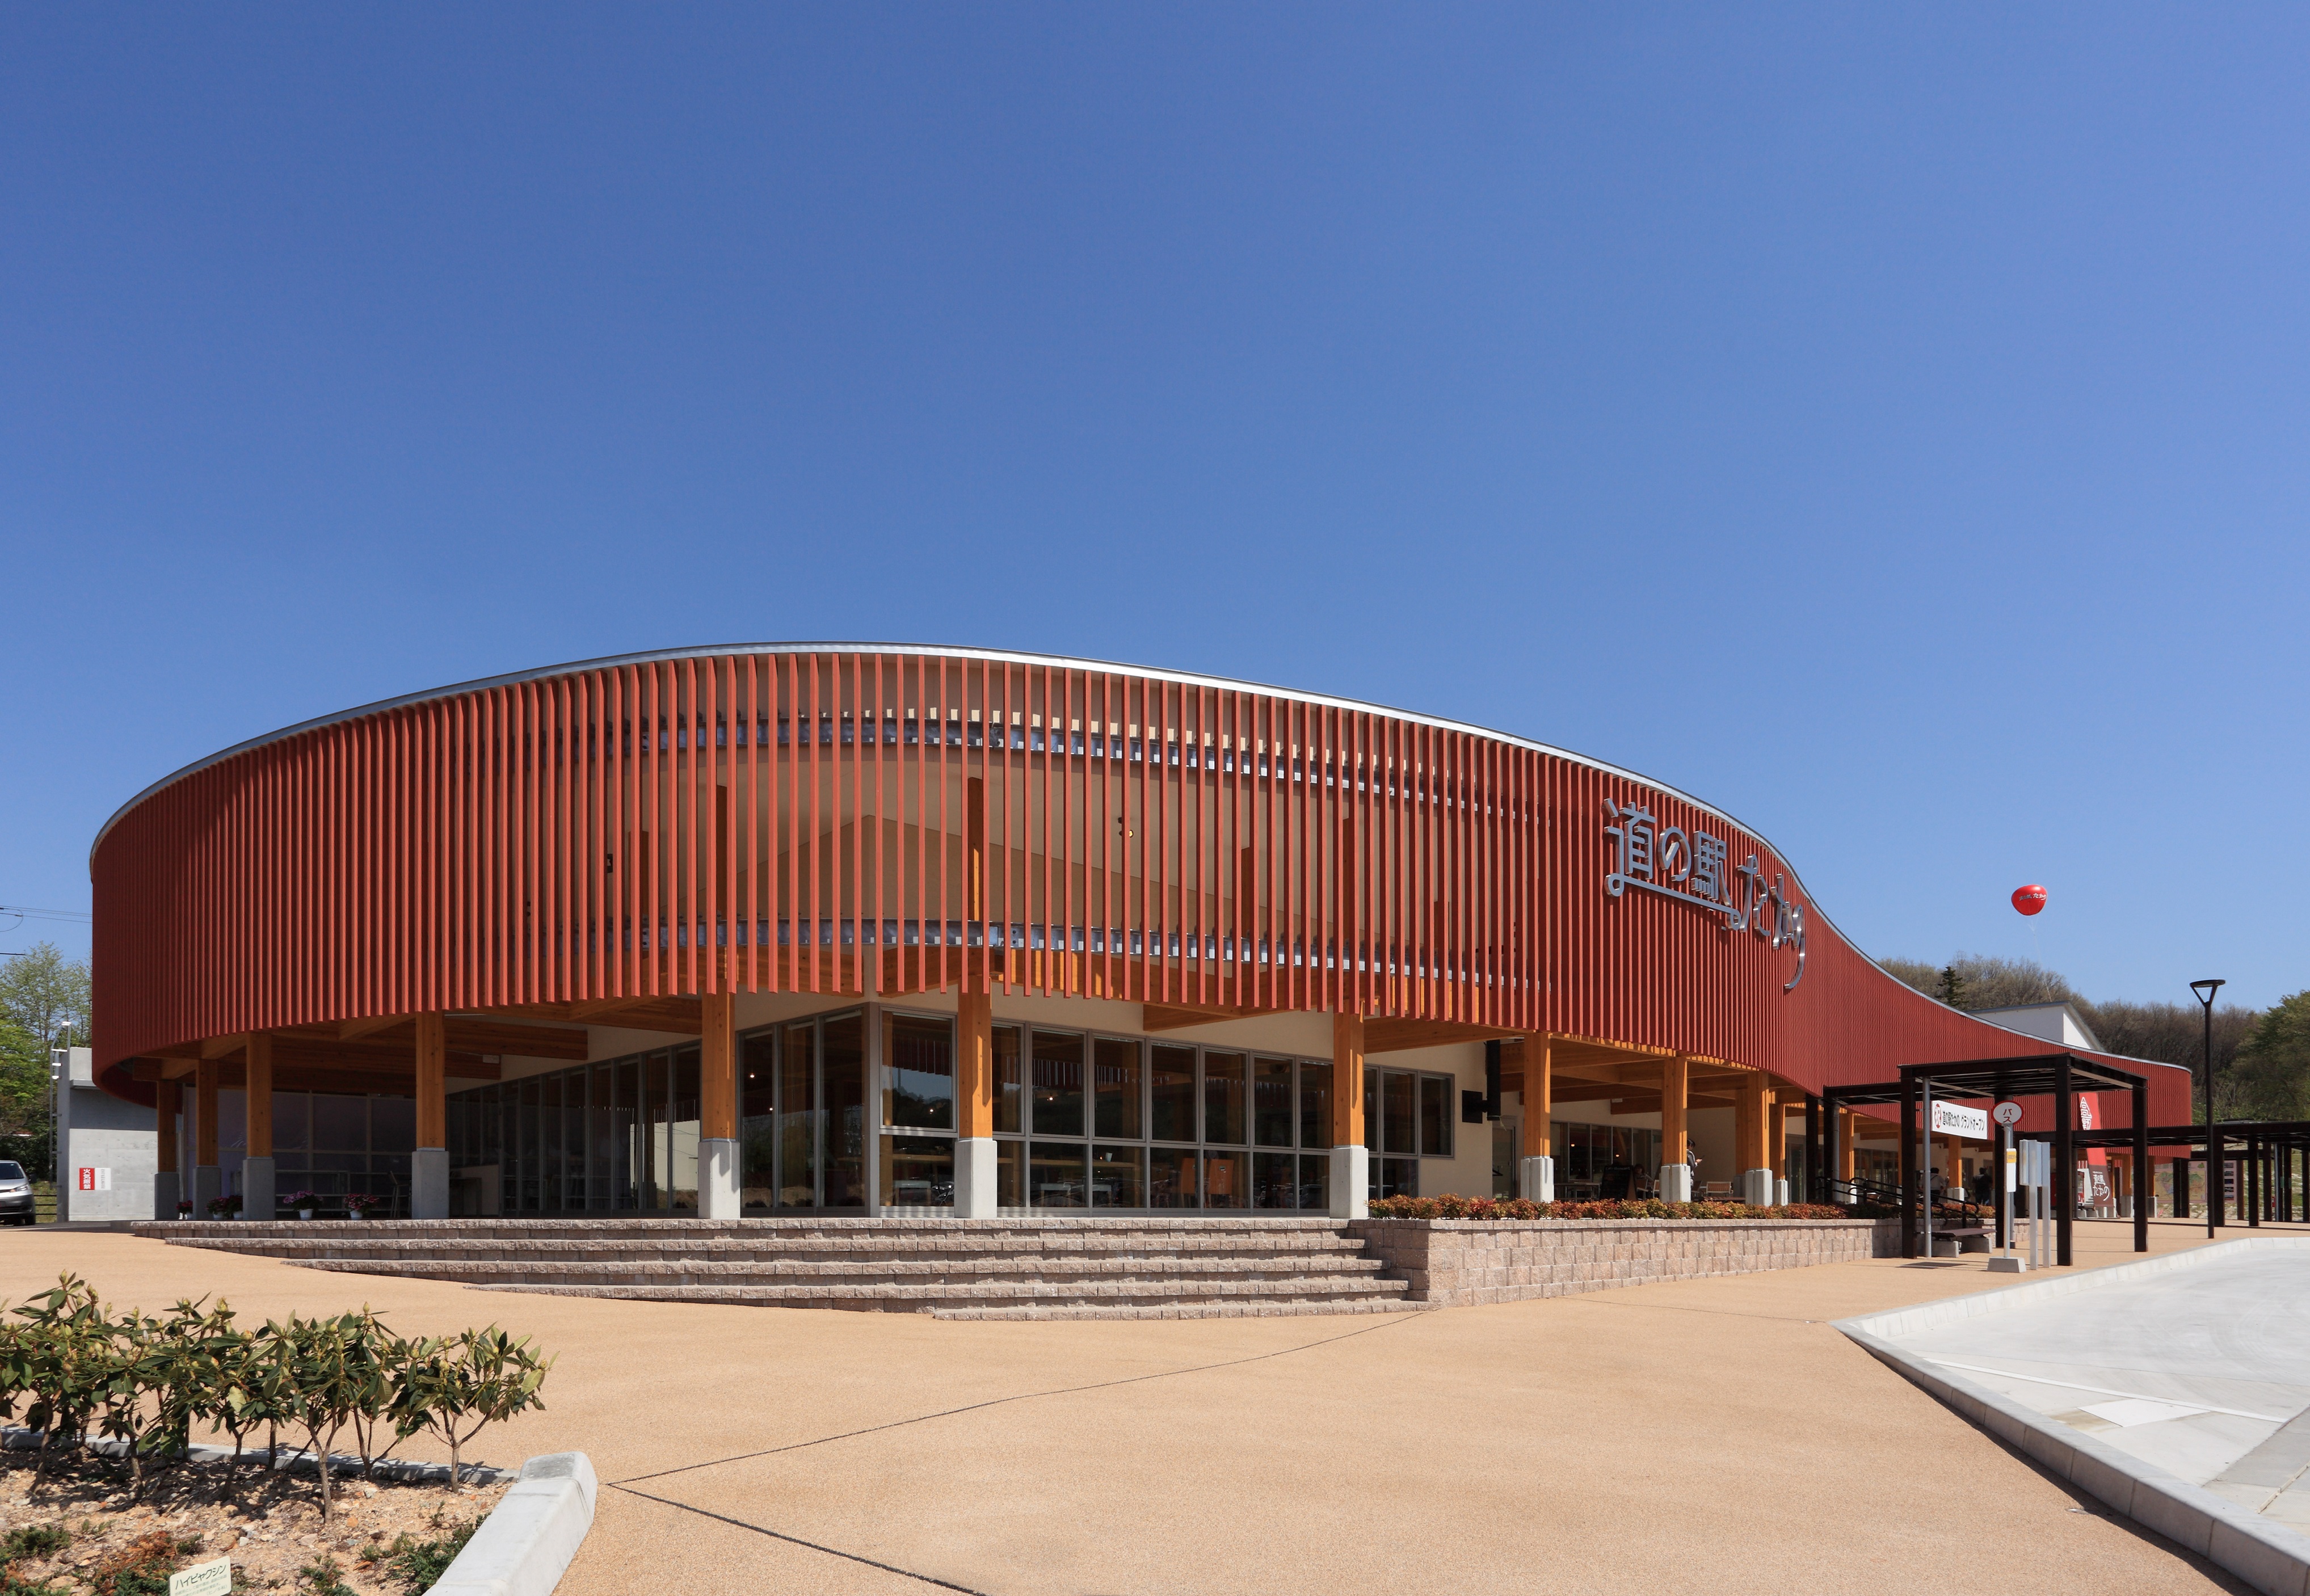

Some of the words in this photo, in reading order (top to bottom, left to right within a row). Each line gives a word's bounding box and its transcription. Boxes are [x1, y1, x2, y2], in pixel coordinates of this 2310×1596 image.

[1960, 1114, 1985, 1131] グランドオープン
[2003, 1108, 2012, 1123] バス
[175, 1564, 226, 1590] ハイビャクシン
